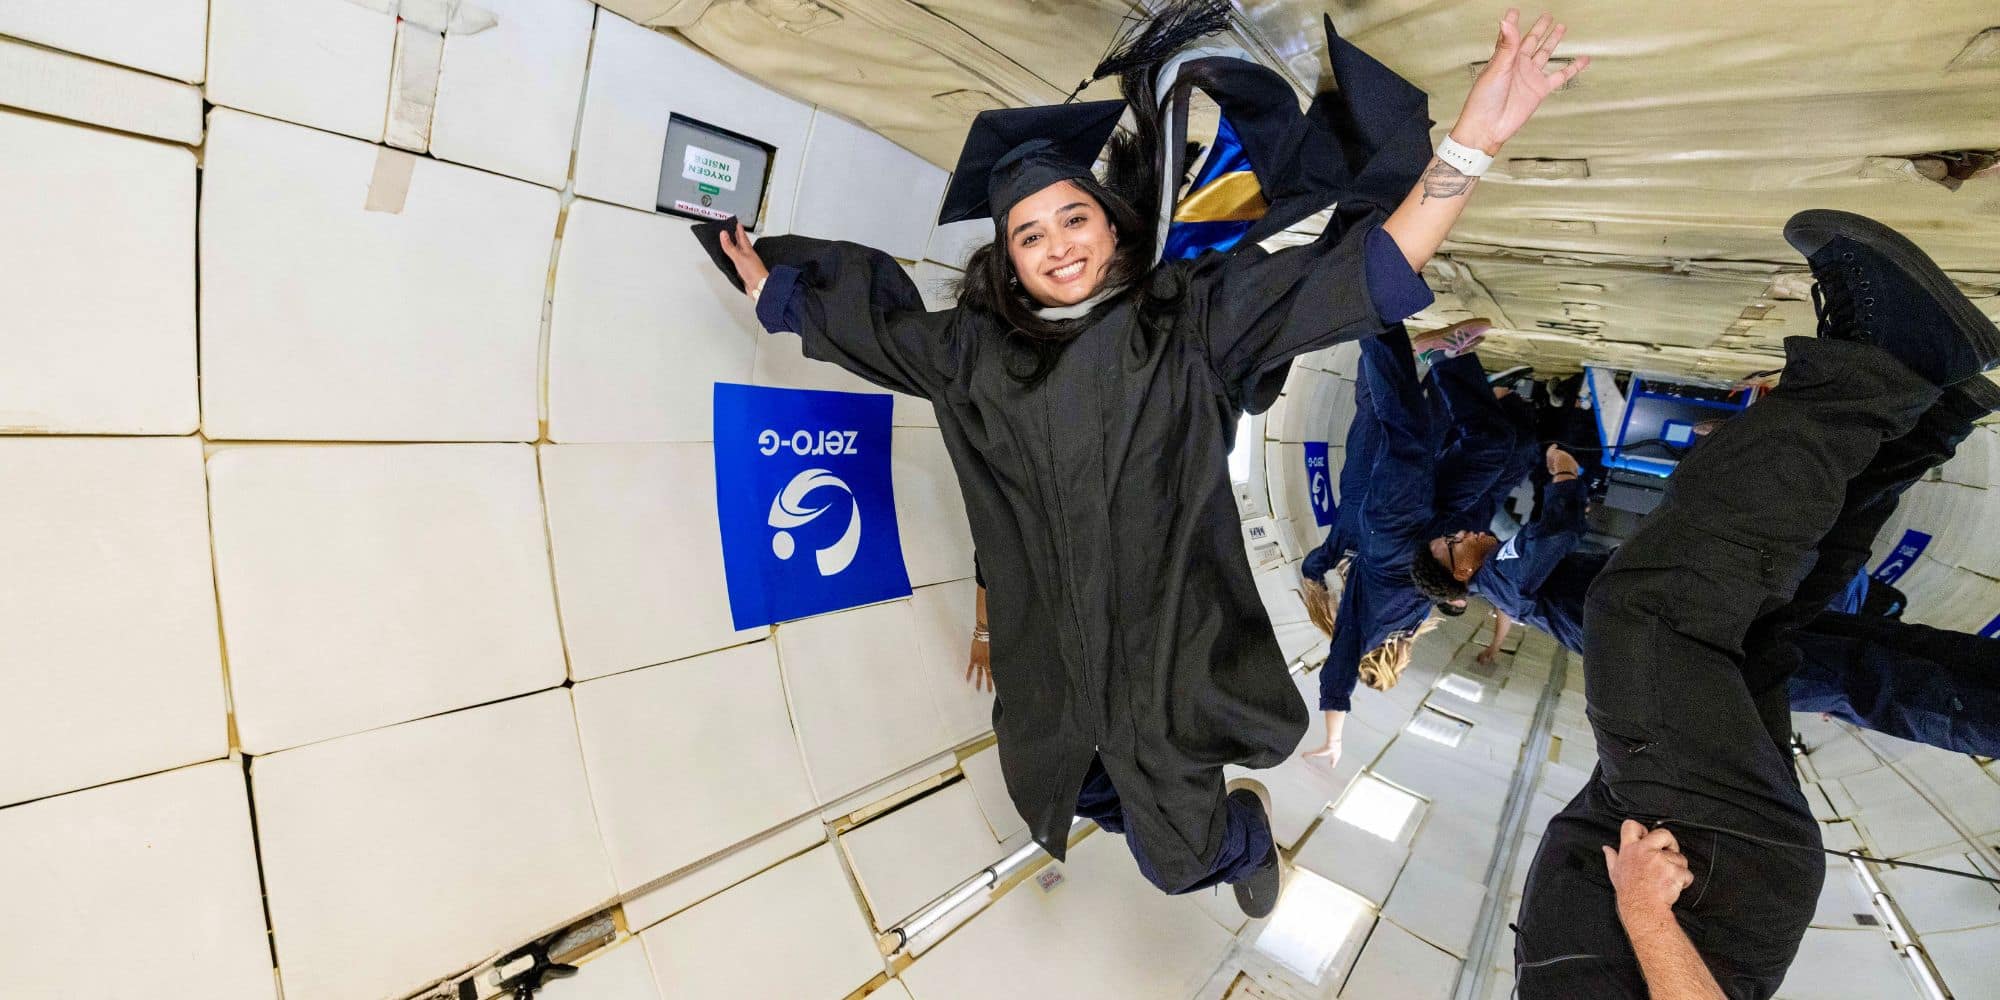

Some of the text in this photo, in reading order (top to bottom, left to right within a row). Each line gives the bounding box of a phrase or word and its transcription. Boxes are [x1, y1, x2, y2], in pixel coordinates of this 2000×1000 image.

[695, 154, 730, 172] INSIDE
[688, 164, 732, 183] OXYGEN
[677, 203, 699, 214] OPEN
